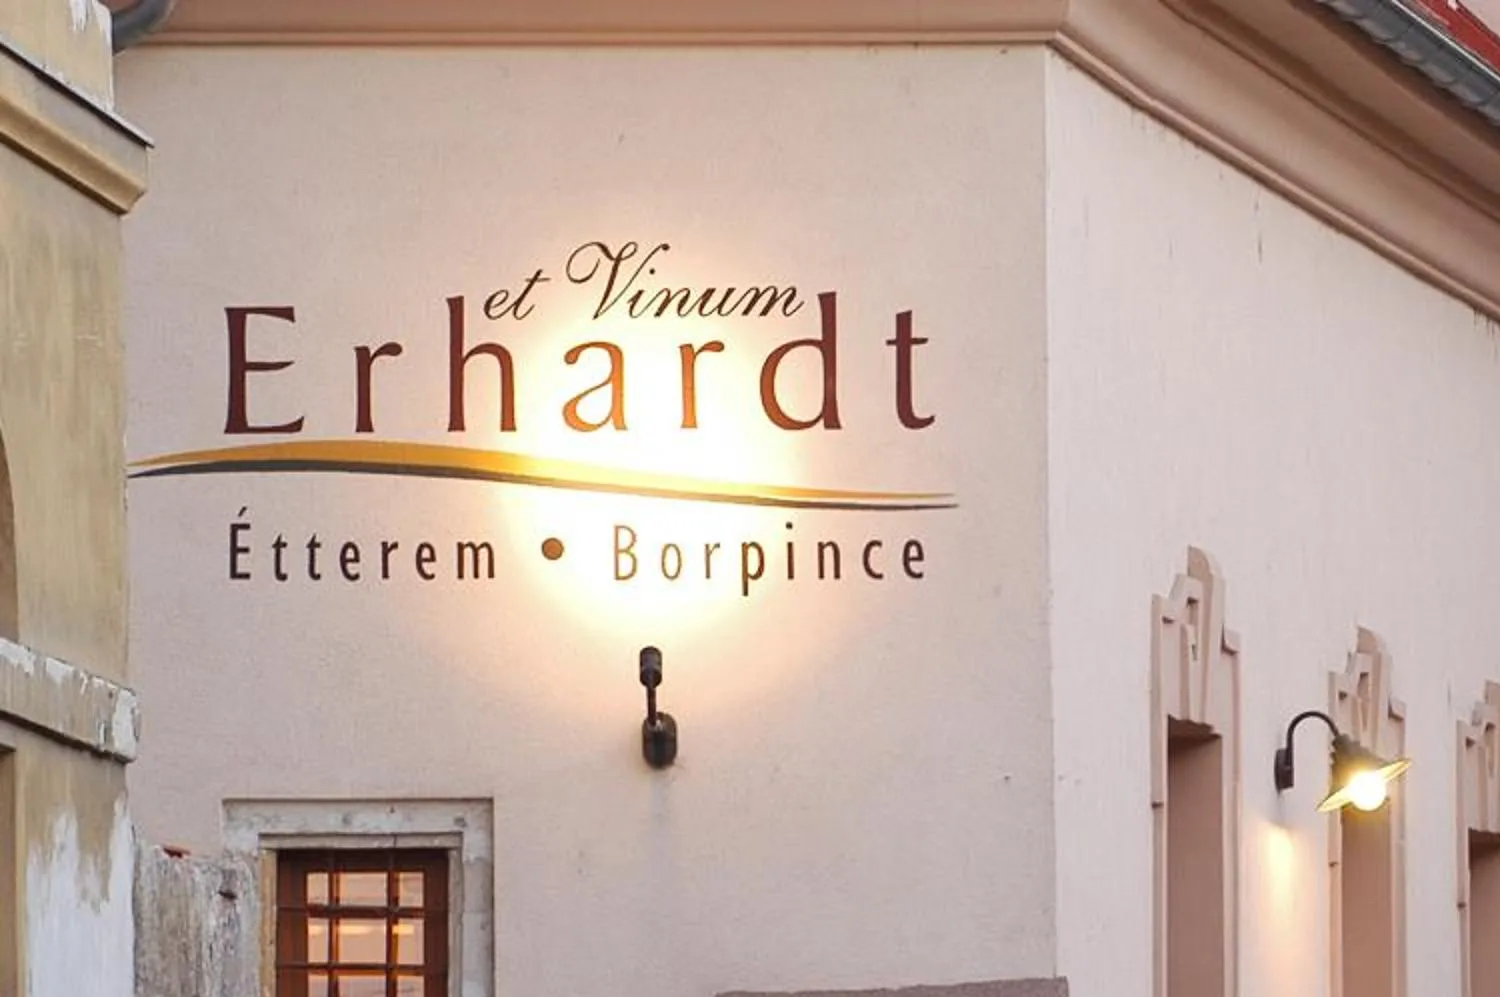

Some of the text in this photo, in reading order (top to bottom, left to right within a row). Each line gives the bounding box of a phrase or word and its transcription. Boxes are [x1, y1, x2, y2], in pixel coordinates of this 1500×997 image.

[484, 241, 806, 322] et Vinum
[223, 290, 937, 436] Erhardt
[229, 505, 926, 599] Étterem Borpince
